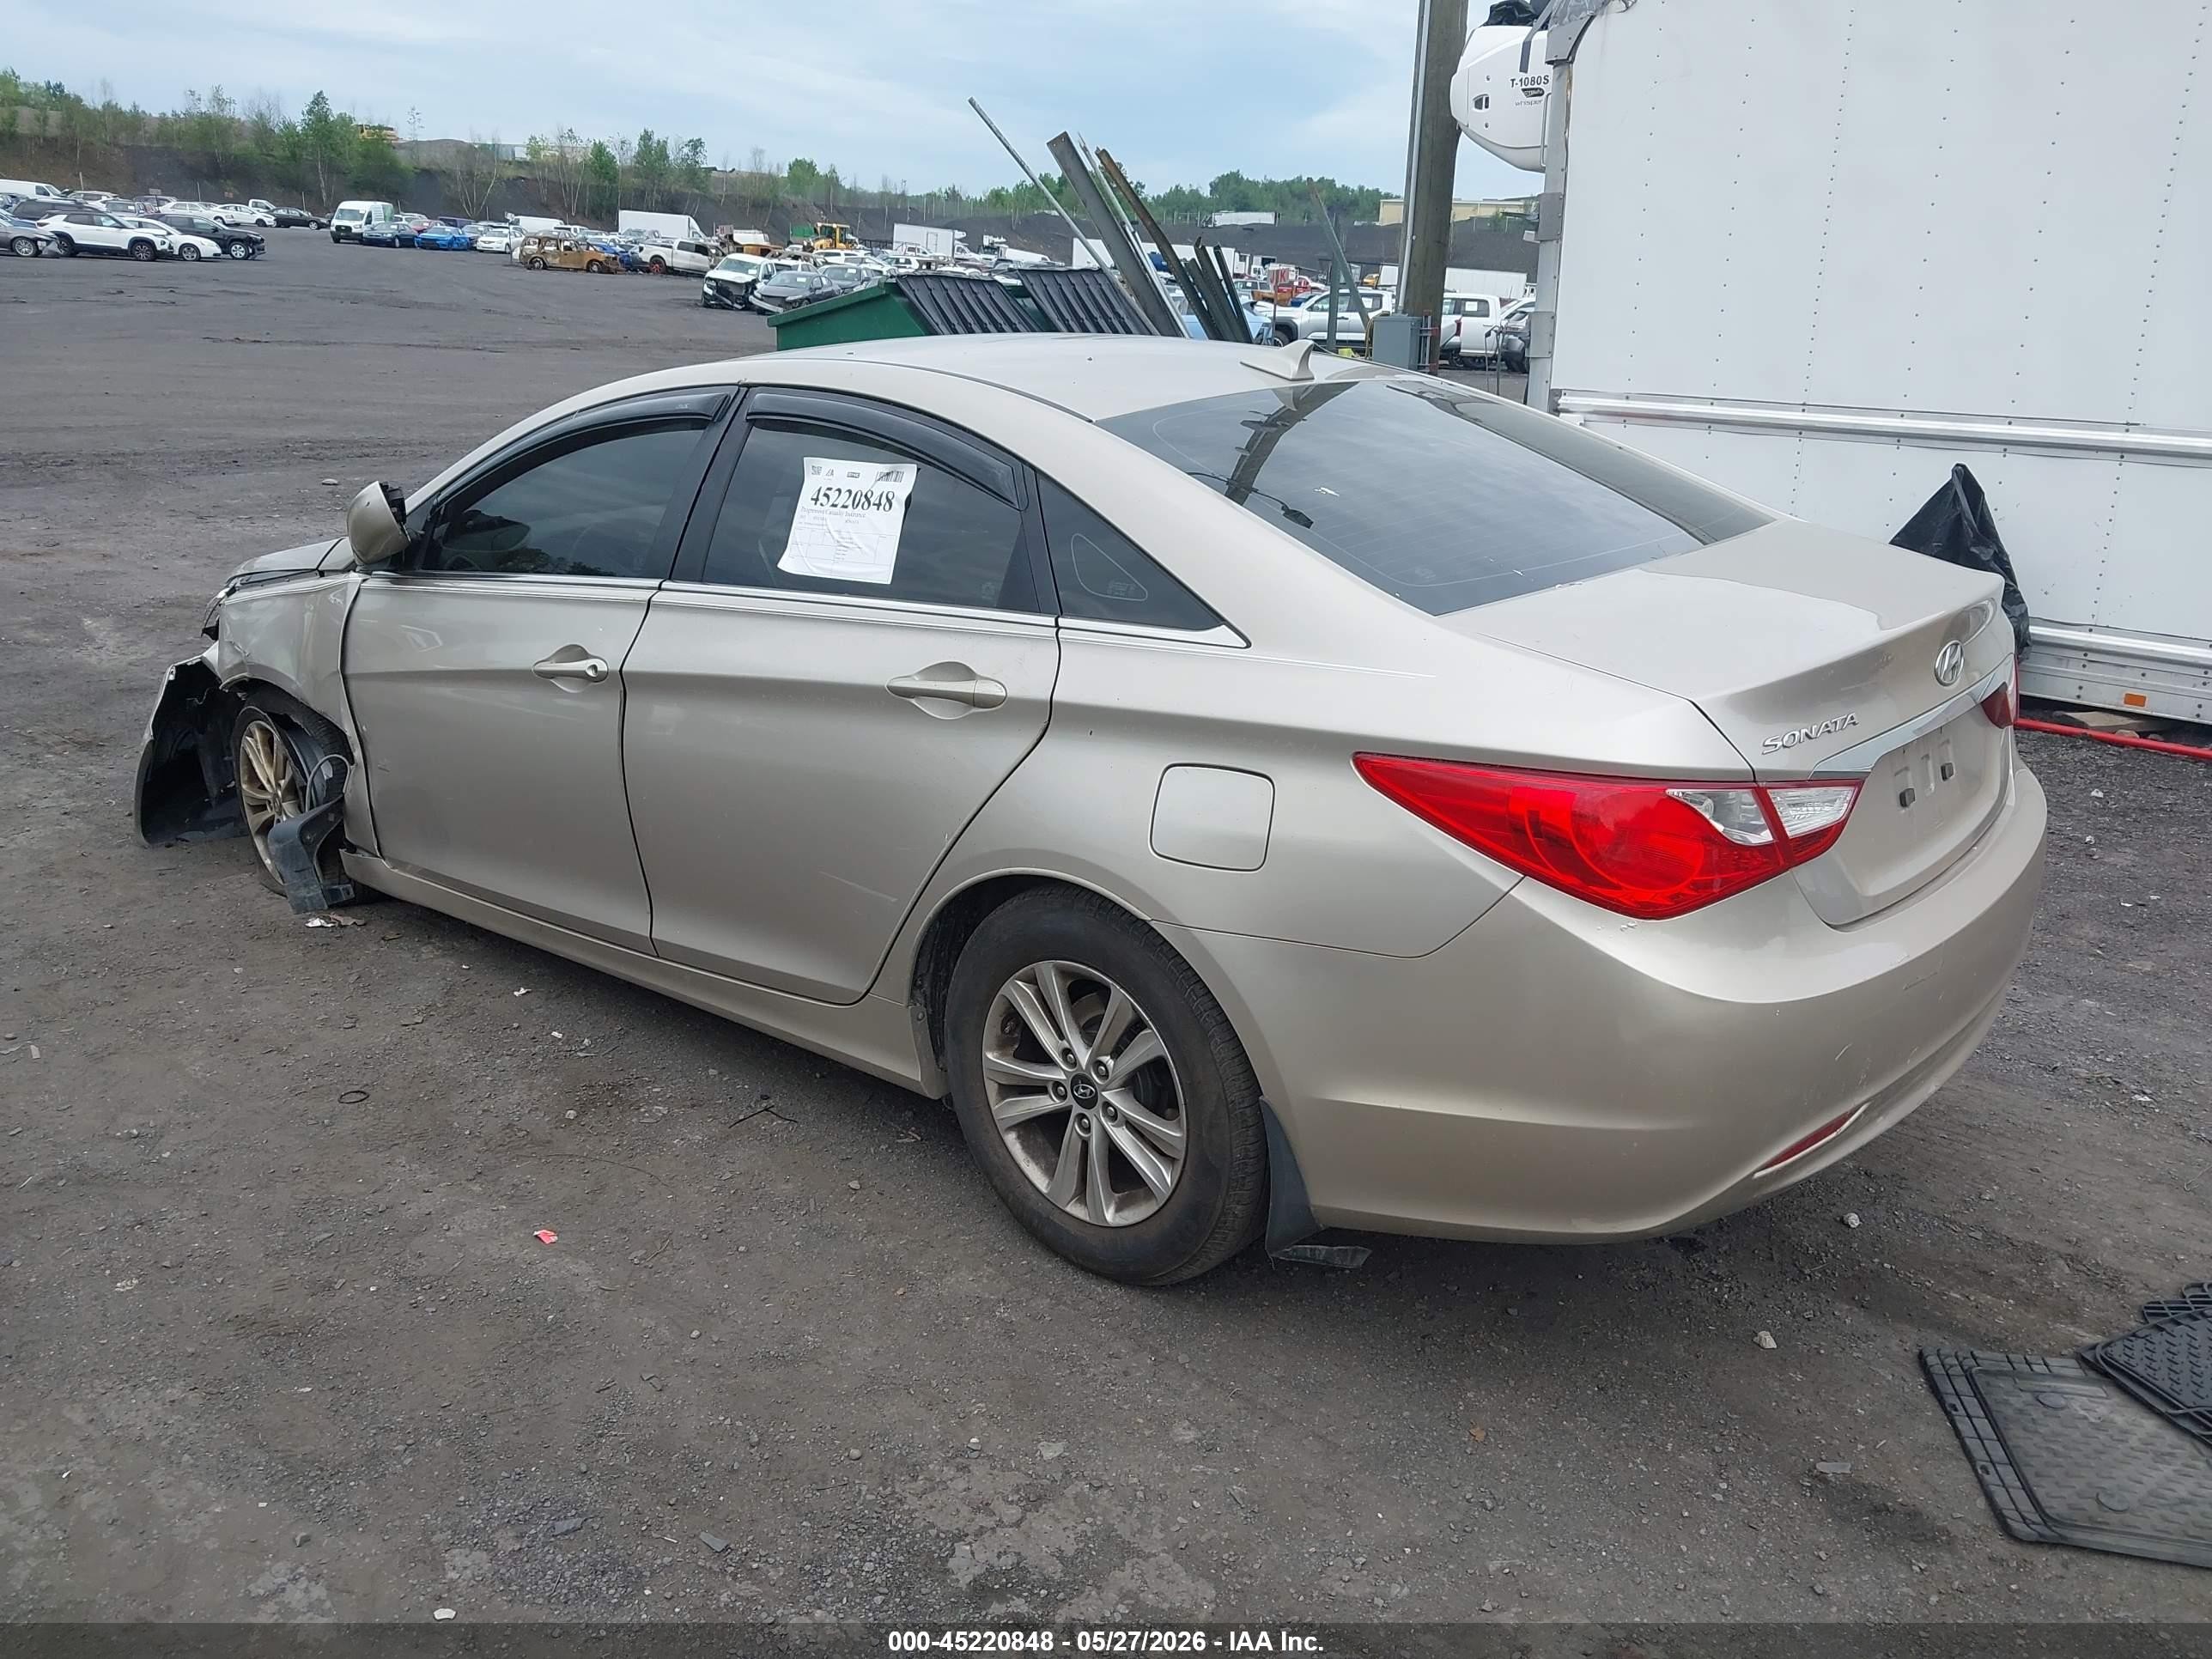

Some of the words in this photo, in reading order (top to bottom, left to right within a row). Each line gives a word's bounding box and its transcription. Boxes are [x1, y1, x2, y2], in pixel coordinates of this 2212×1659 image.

[1510, 75, 1549, 88] T-1080S
[811, 486, 895, 512] 45220848
[1761, 712, 1858, 754] SONATA
